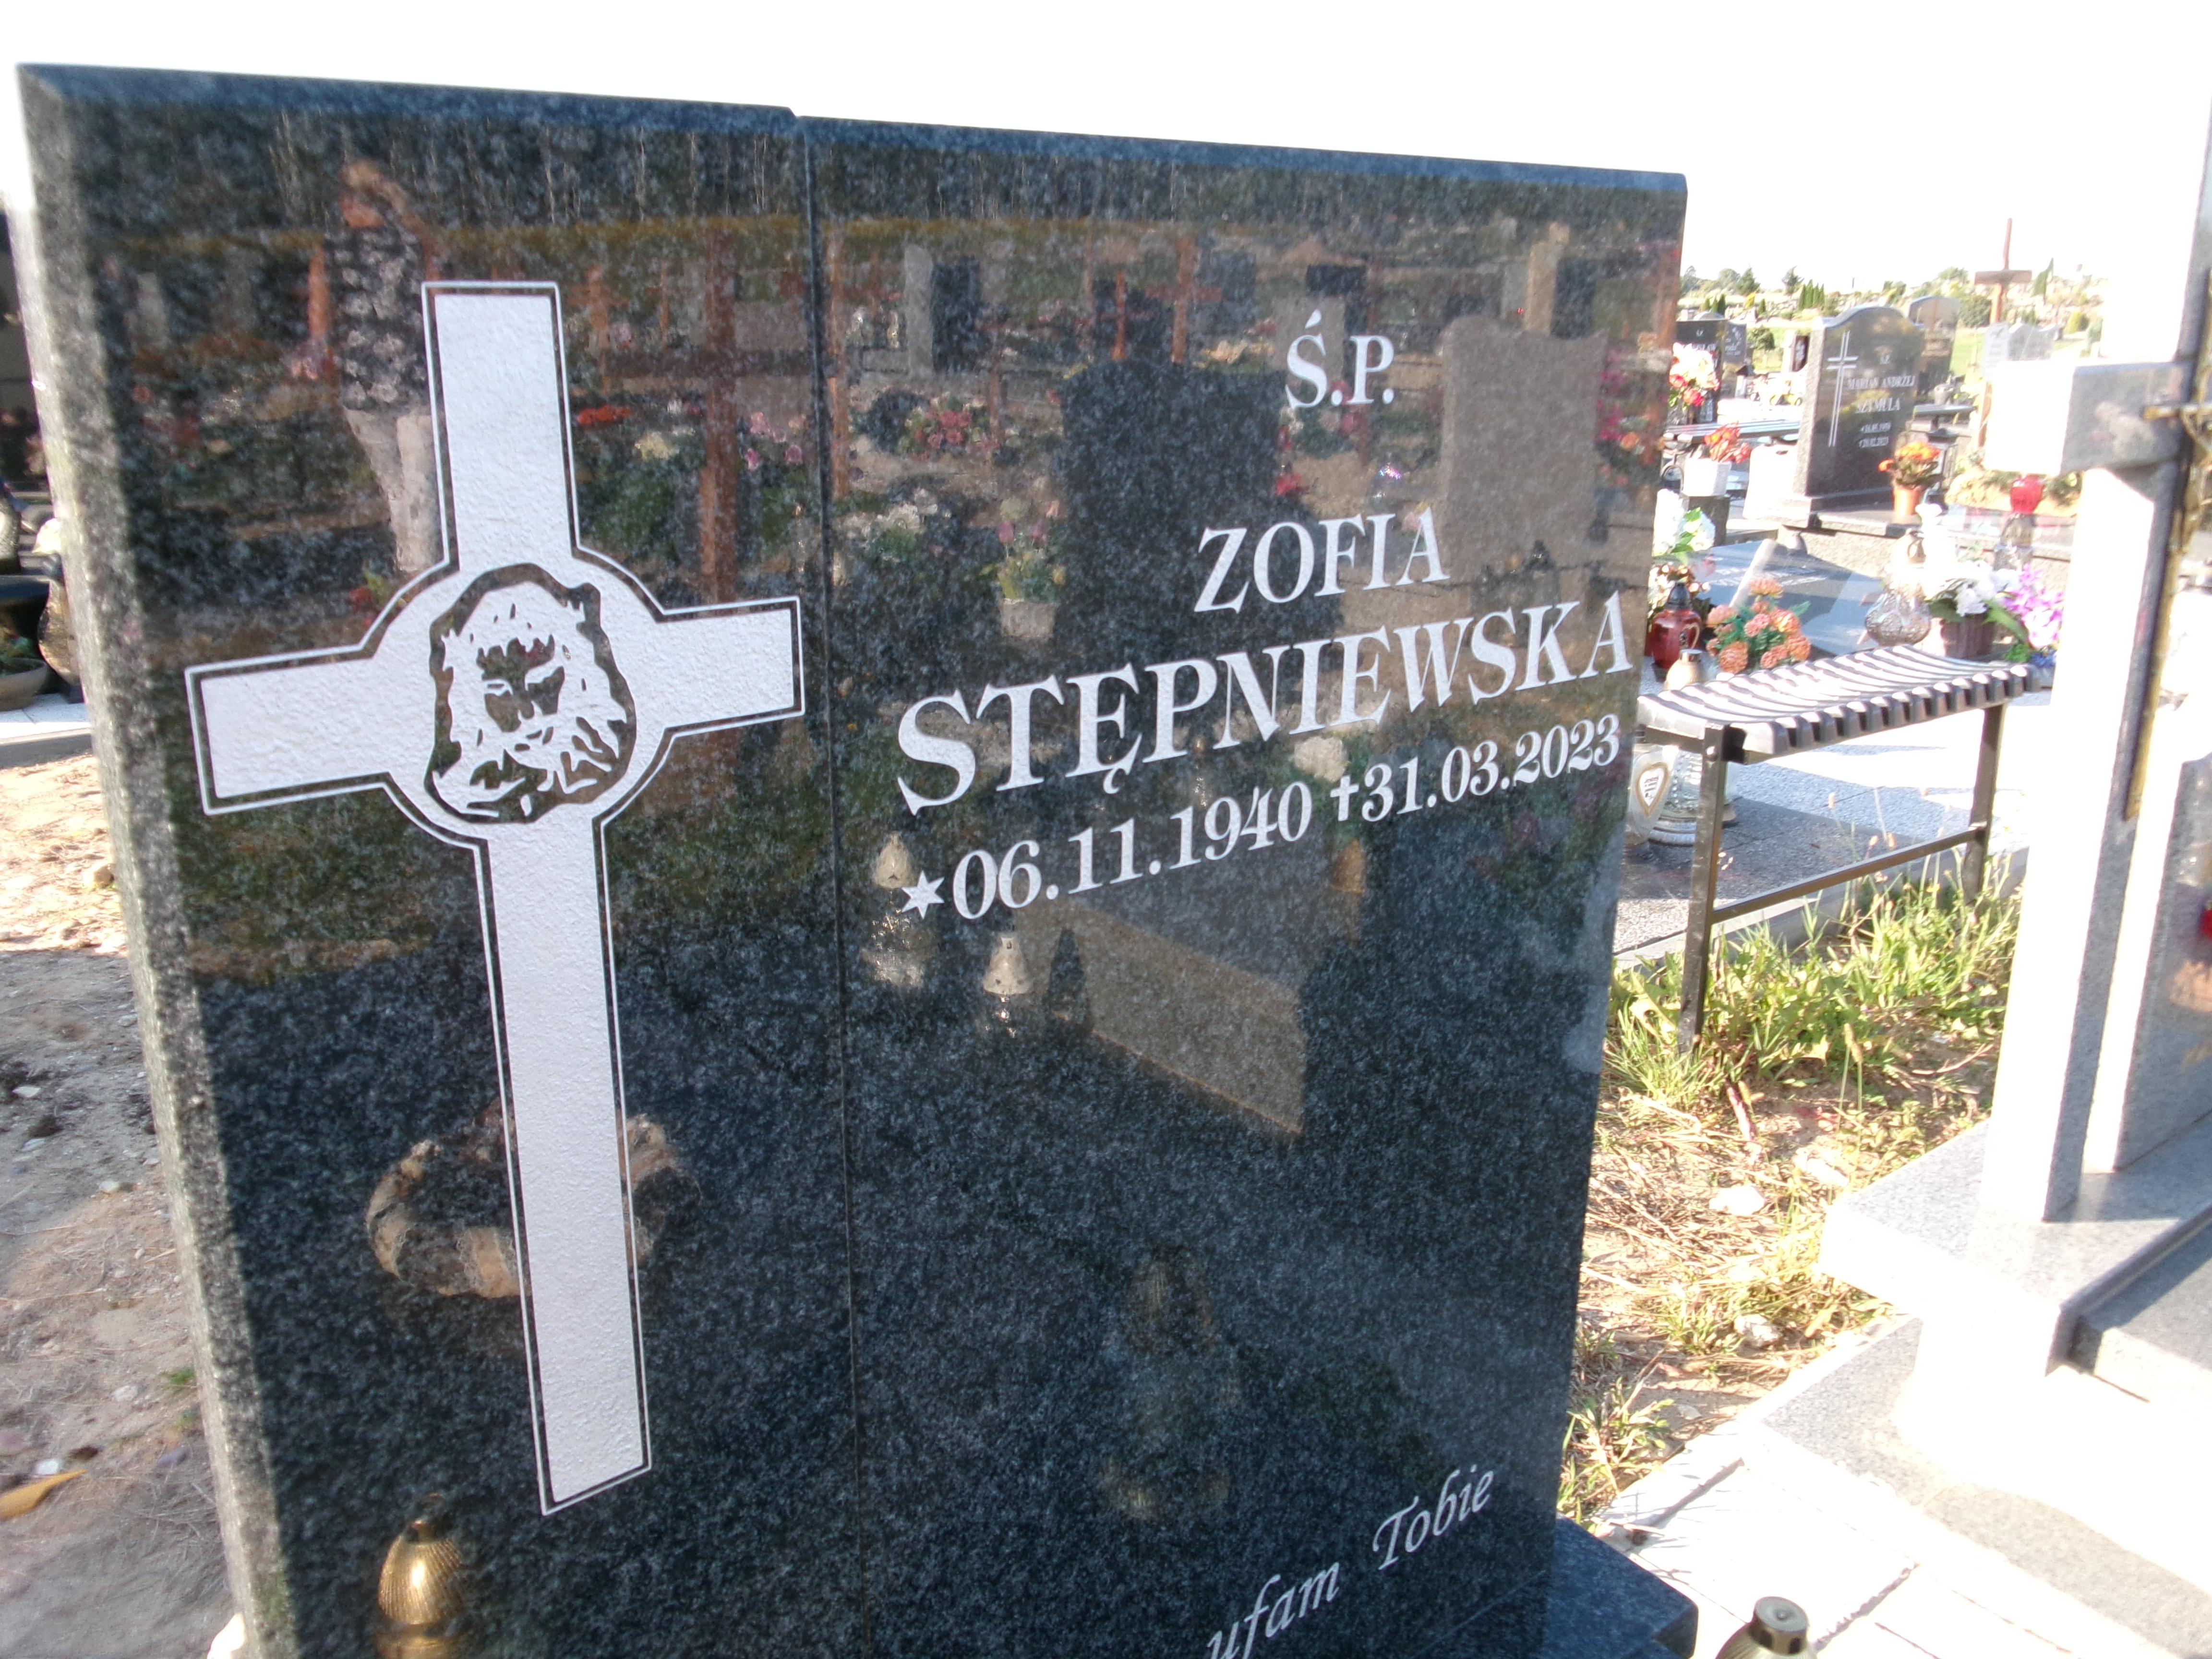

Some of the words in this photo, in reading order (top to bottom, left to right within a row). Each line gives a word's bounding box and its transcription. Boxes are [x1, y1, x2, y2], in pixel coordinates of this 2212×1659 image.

[1285, 308, 1395, 409] Ś.P.
[1193, 505, 1451, 613] ZOFIA
[897, 590, 1634, 816] STĘPNIEWSKA
[1206, 1562, 1339, 1659] ufam
[1372, 1464, 1494, 1570] Tobie
